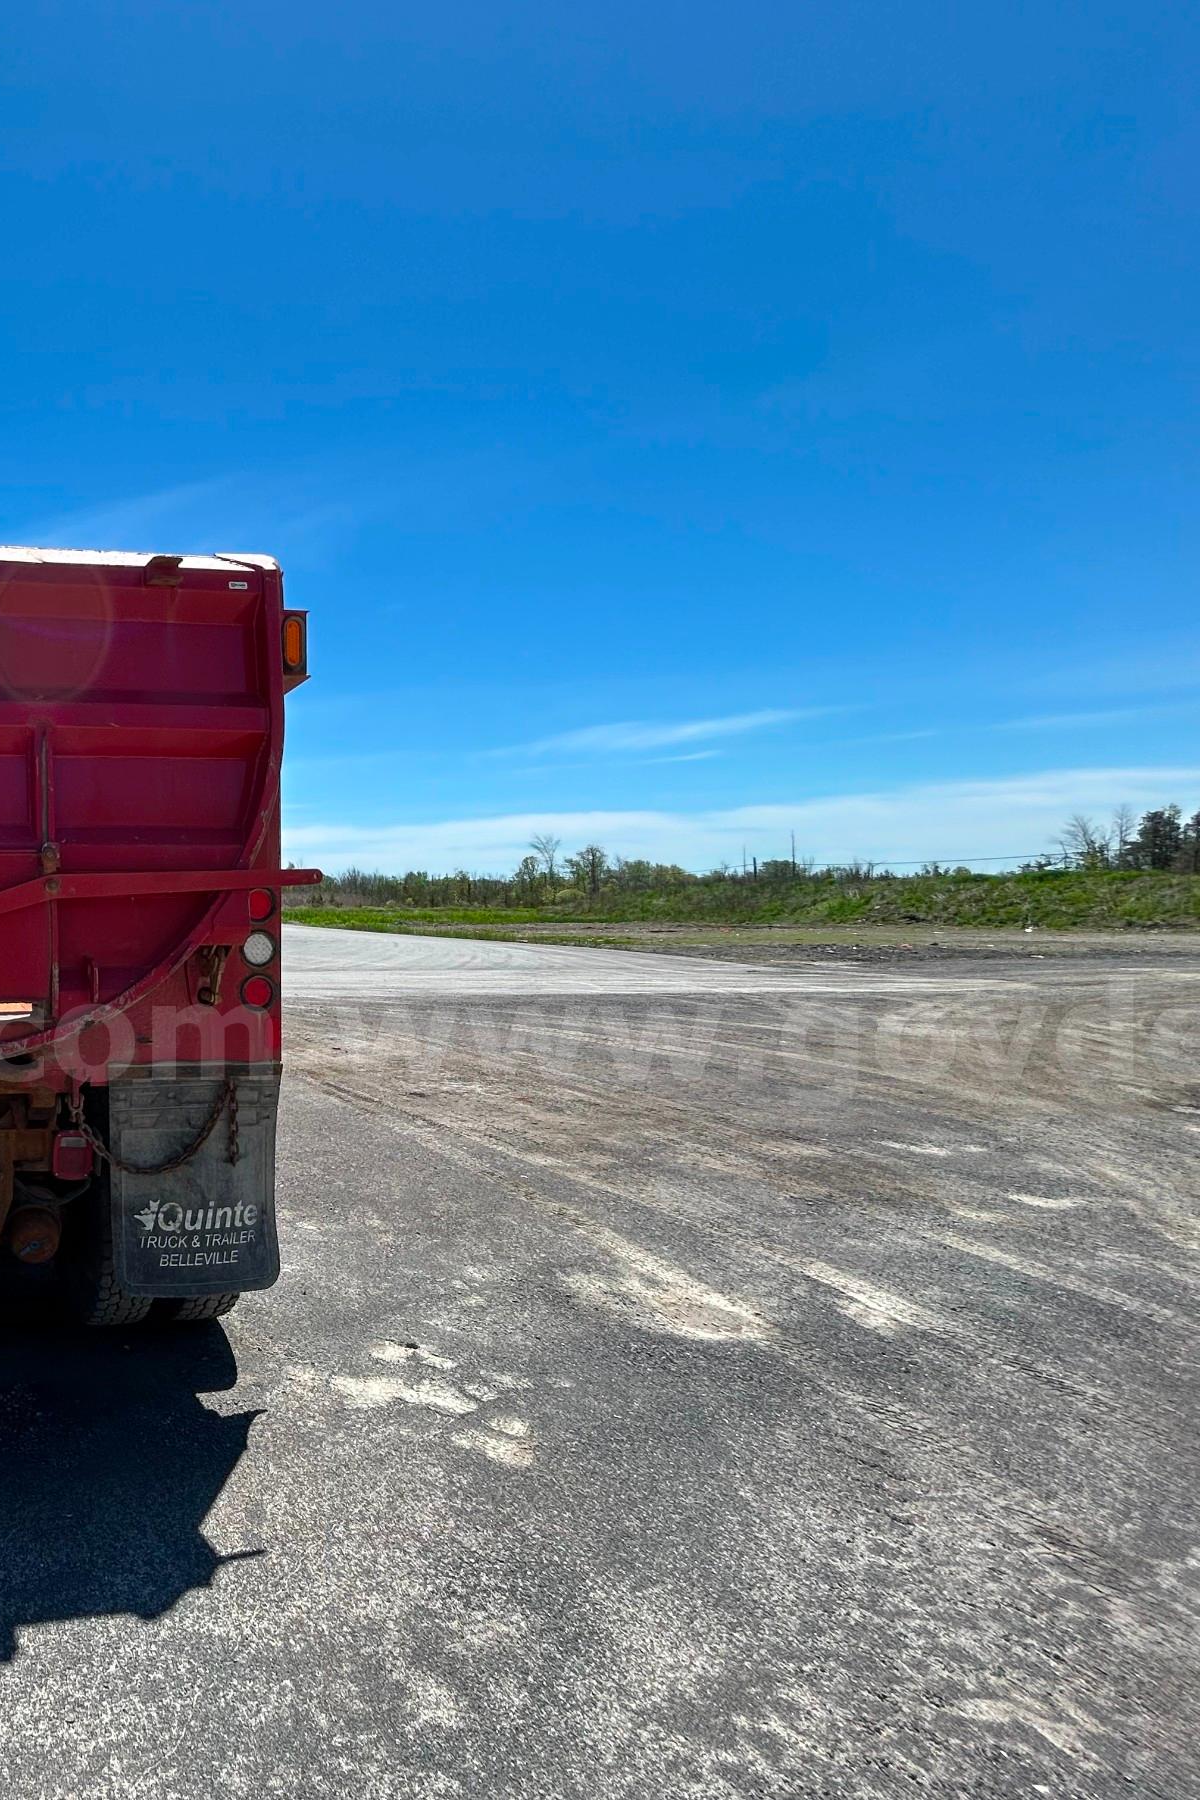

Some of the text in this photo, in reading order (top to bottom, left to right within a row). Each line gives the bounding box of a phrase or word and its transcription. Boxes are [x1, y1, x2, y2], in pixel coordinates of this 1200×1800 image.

[157, 1199, 259, 1234] Quinte
[140, 1229, 256, 1249] TRUCK & TRAILER
[159, 1249, 239, 1267] BELLEVILLE
